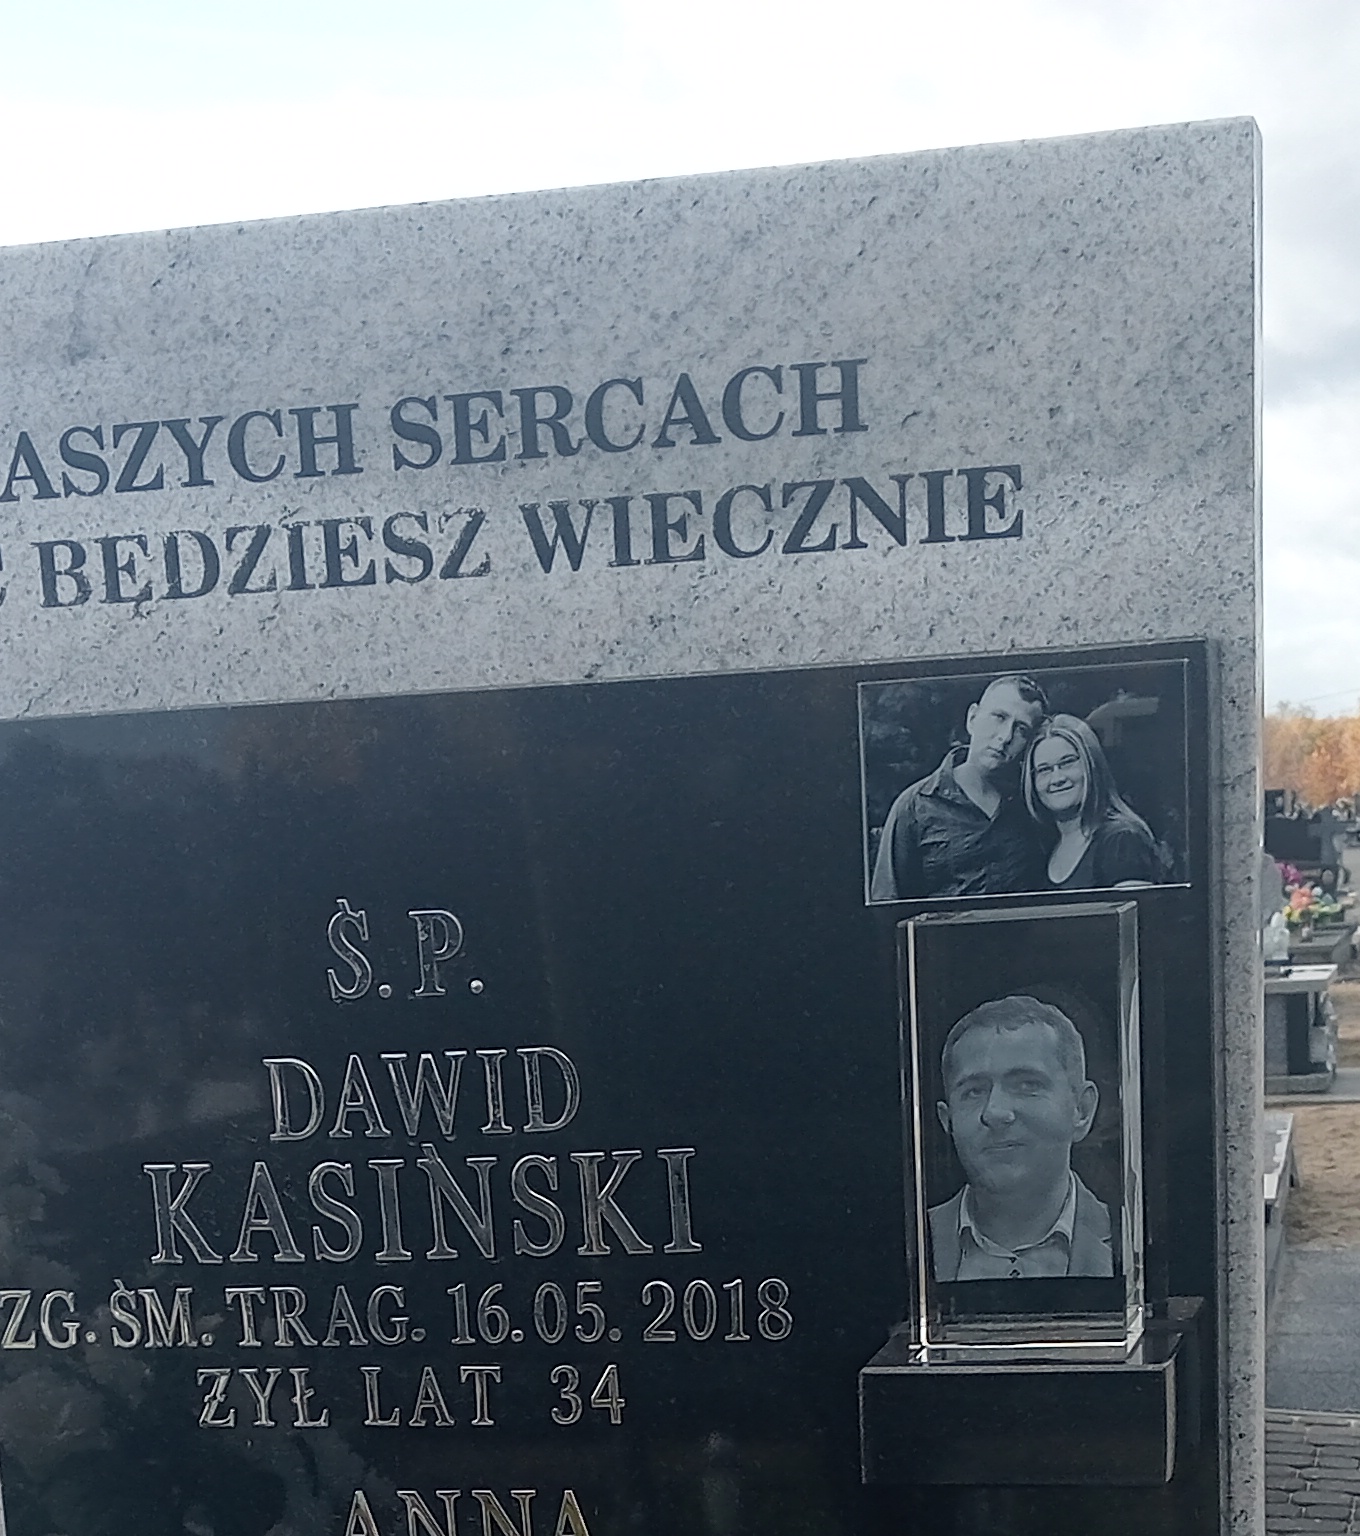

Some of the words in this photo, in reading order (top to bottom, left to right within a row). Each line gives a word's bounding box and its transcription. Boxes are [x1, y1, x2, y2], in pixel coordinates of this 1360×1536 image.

[390, 358, 868, 472] SERCACH
[520, 464, 1025, 574] WIECZNIE
[408, 909, 484, 997] P.
[262, 1046, 582, 1141] DAWID
[225, 1285, 427, 1348] TRAG.
[360, 1365, 501, 1428] LAT
[549, 1363, 626, 1426] 34
